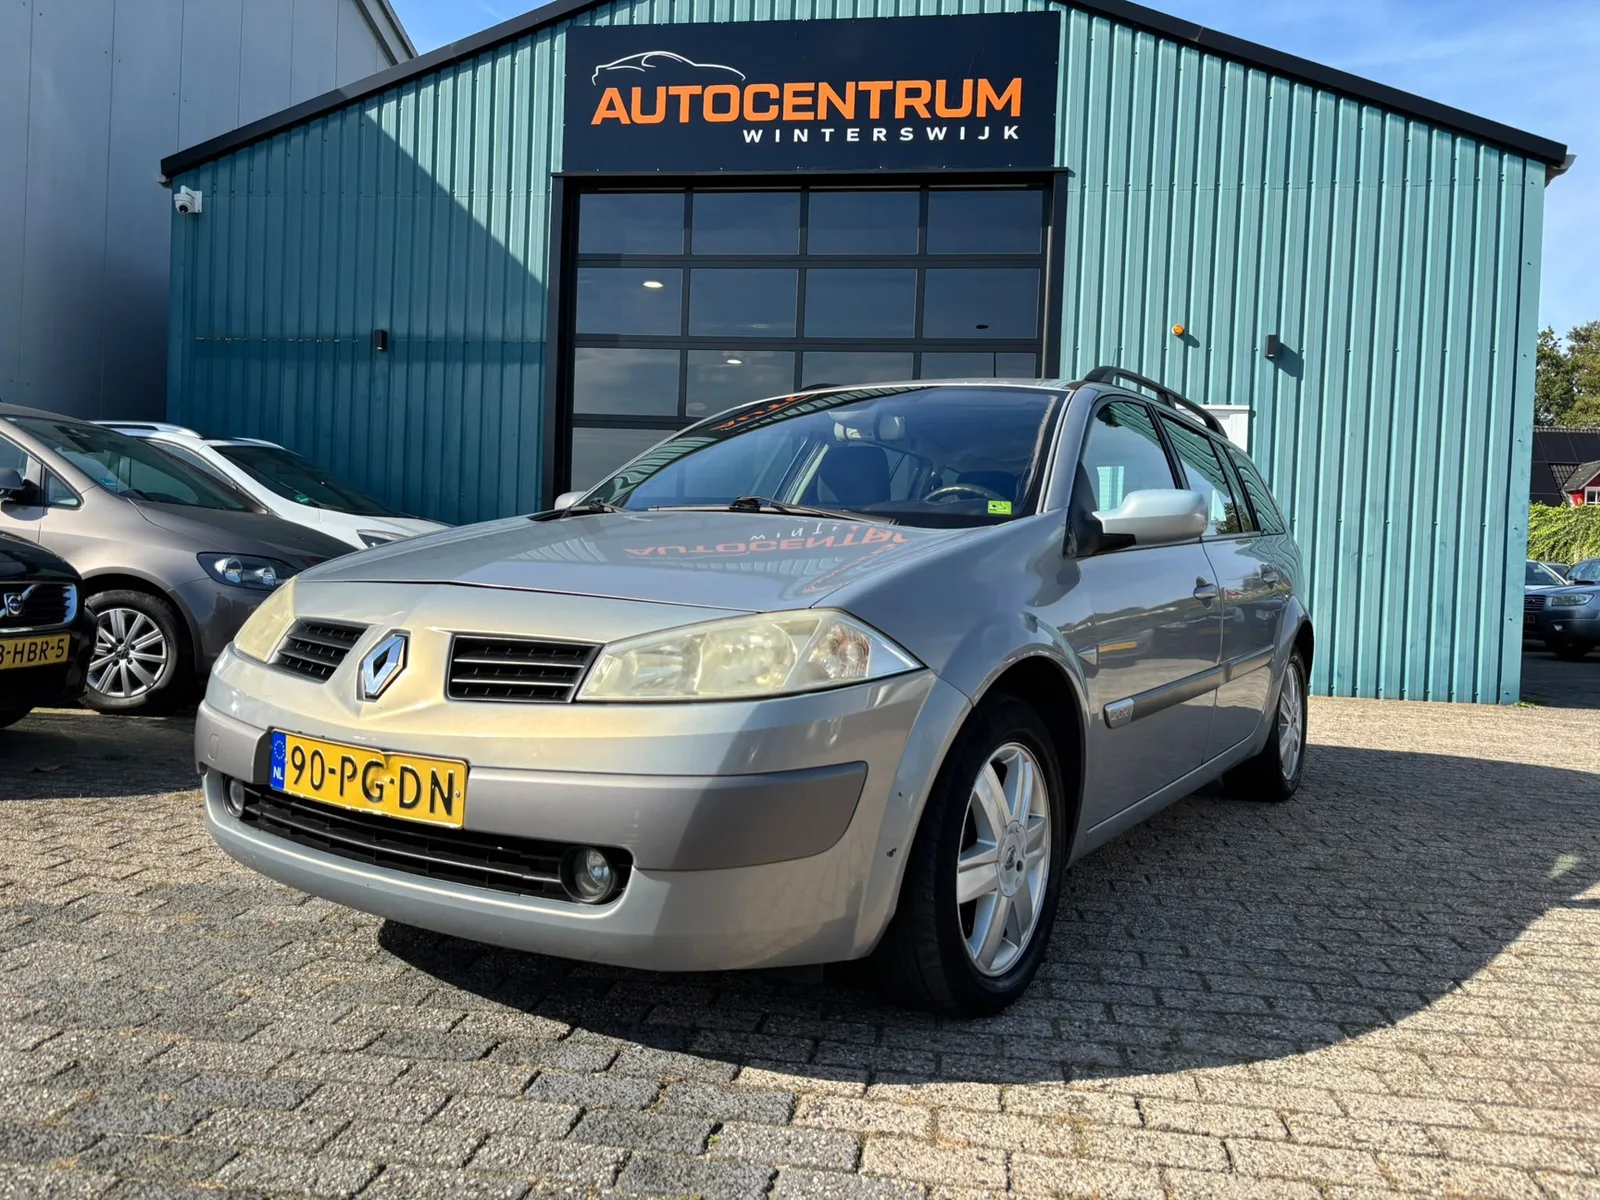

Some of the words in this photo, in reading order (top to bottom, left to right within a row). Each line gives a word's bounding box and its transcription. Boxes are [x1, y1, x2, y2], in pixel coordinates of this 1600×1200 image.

[591, 78, 1022, 125] AUTOCENTRUM
[743, 125, 1019, 143] WINTERSWIJK
[272, 766, 283, 780] NL
[291, 745, 455, 816] 90-PG-DN
